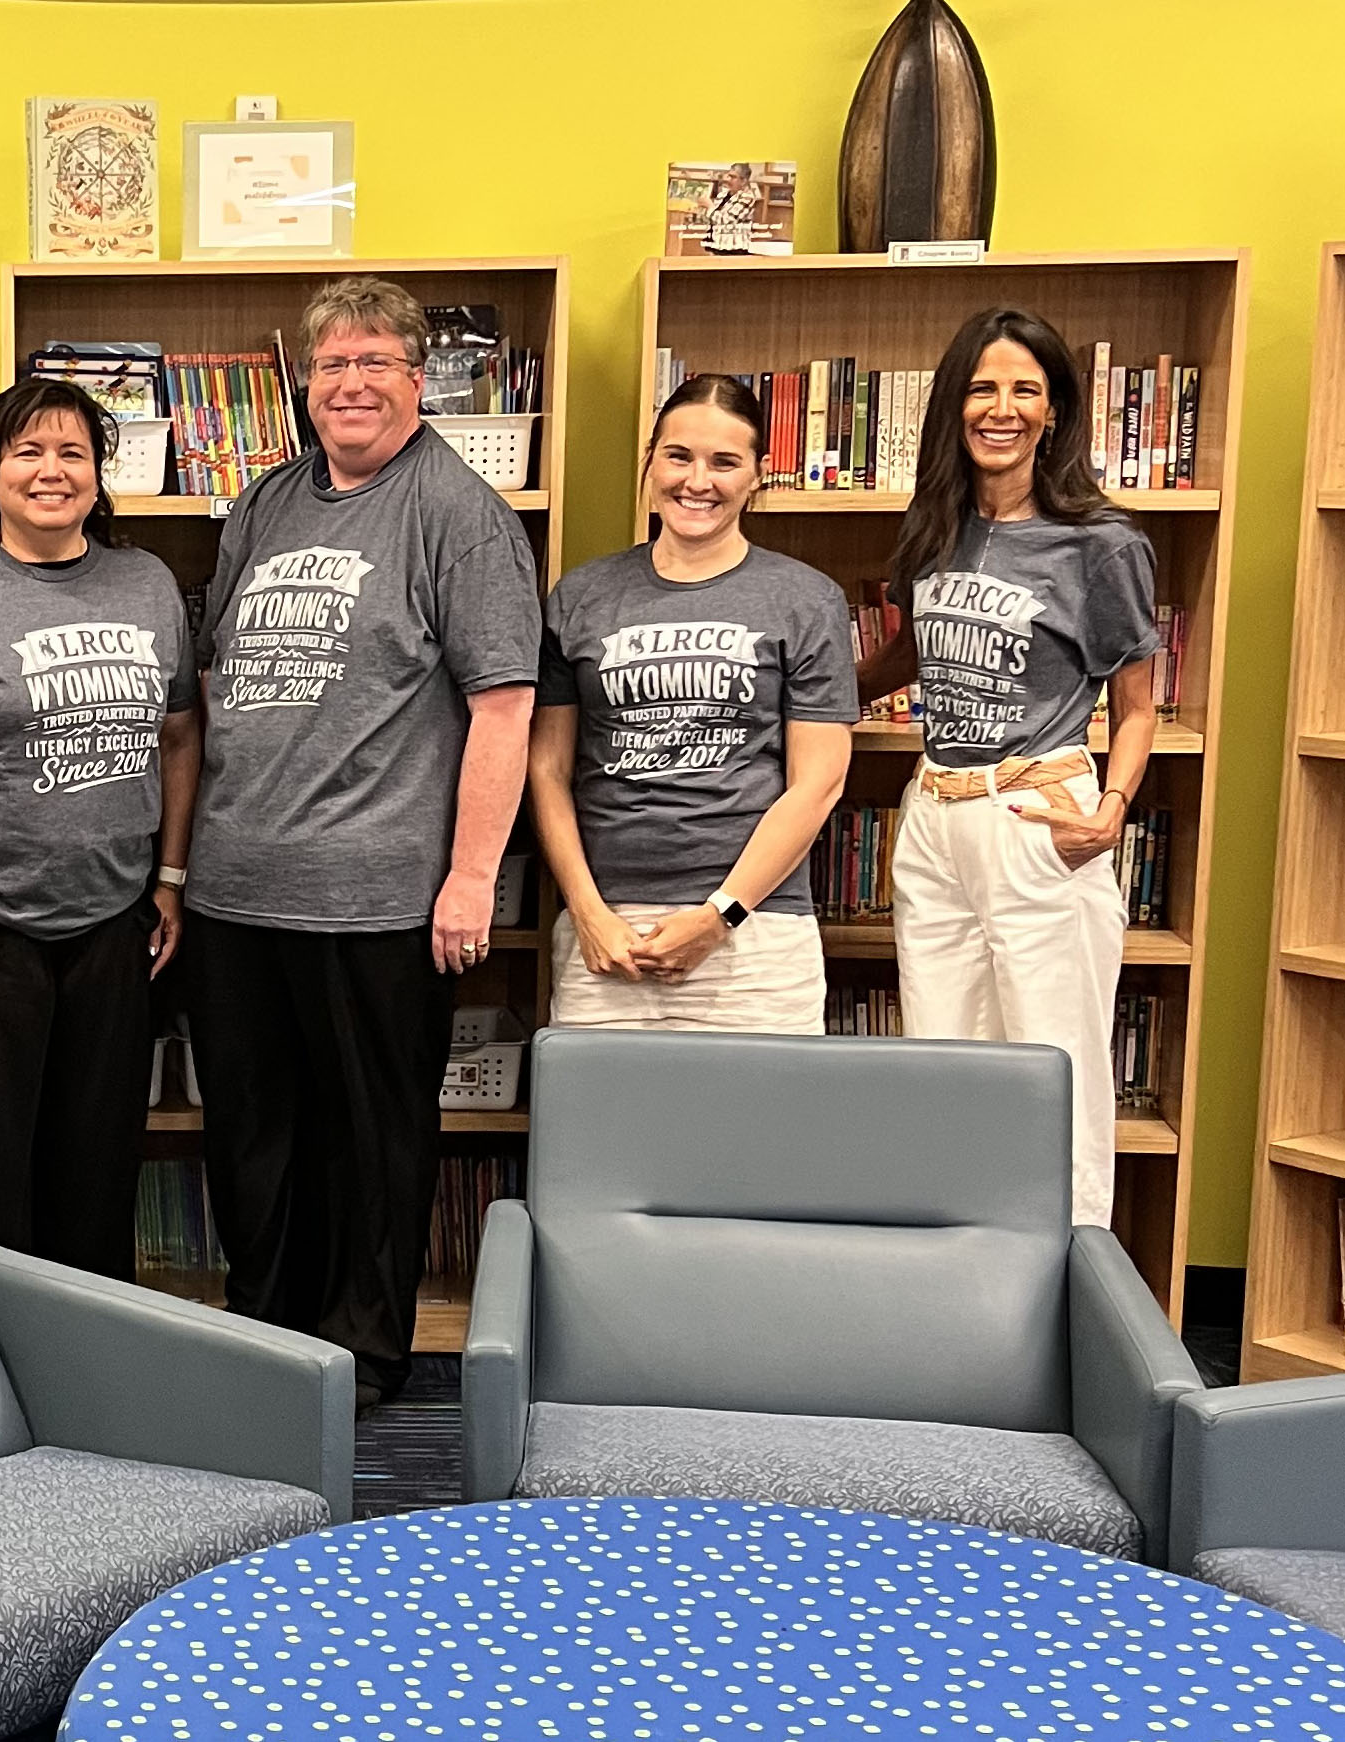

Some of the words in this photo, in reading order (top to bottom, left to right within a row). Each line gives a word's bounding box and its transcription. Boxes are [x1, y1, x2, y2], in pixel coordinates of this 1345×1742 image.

[282, 553, 352, 581] LRCC
[944, 580, 1021, 617] LRCC
[235, 591, 355, 633] WYOMING'S
[57, 630, 134, 658] LRCC
[650, 628, 737, 653] LRCC
[274, 659, 346, 681] EXCELLENCE
[25, 665, 164, 712] WYOMING'S
[223, 676, 277, 710] Since
[279, 678, 327, 701] 2014
[600, 661, 757, 706] WYOMING'S
[42, 710, 93, 730] TRUSTED
[95, 707, 146, 722] PARTNER
[621, 706, 671, 723] TRUSTED
[673, 705, 721, 719] PARTNER
[663, 728, 747, 746] EXCELLENCE
[956, 719, 1007, 743] 2014
[25, 737, 92, 758] LITERACY
[674, 745, 731, 769] 2014
[32, 757, 108, 794] Since
[111, 749, 151, 775] 2014
